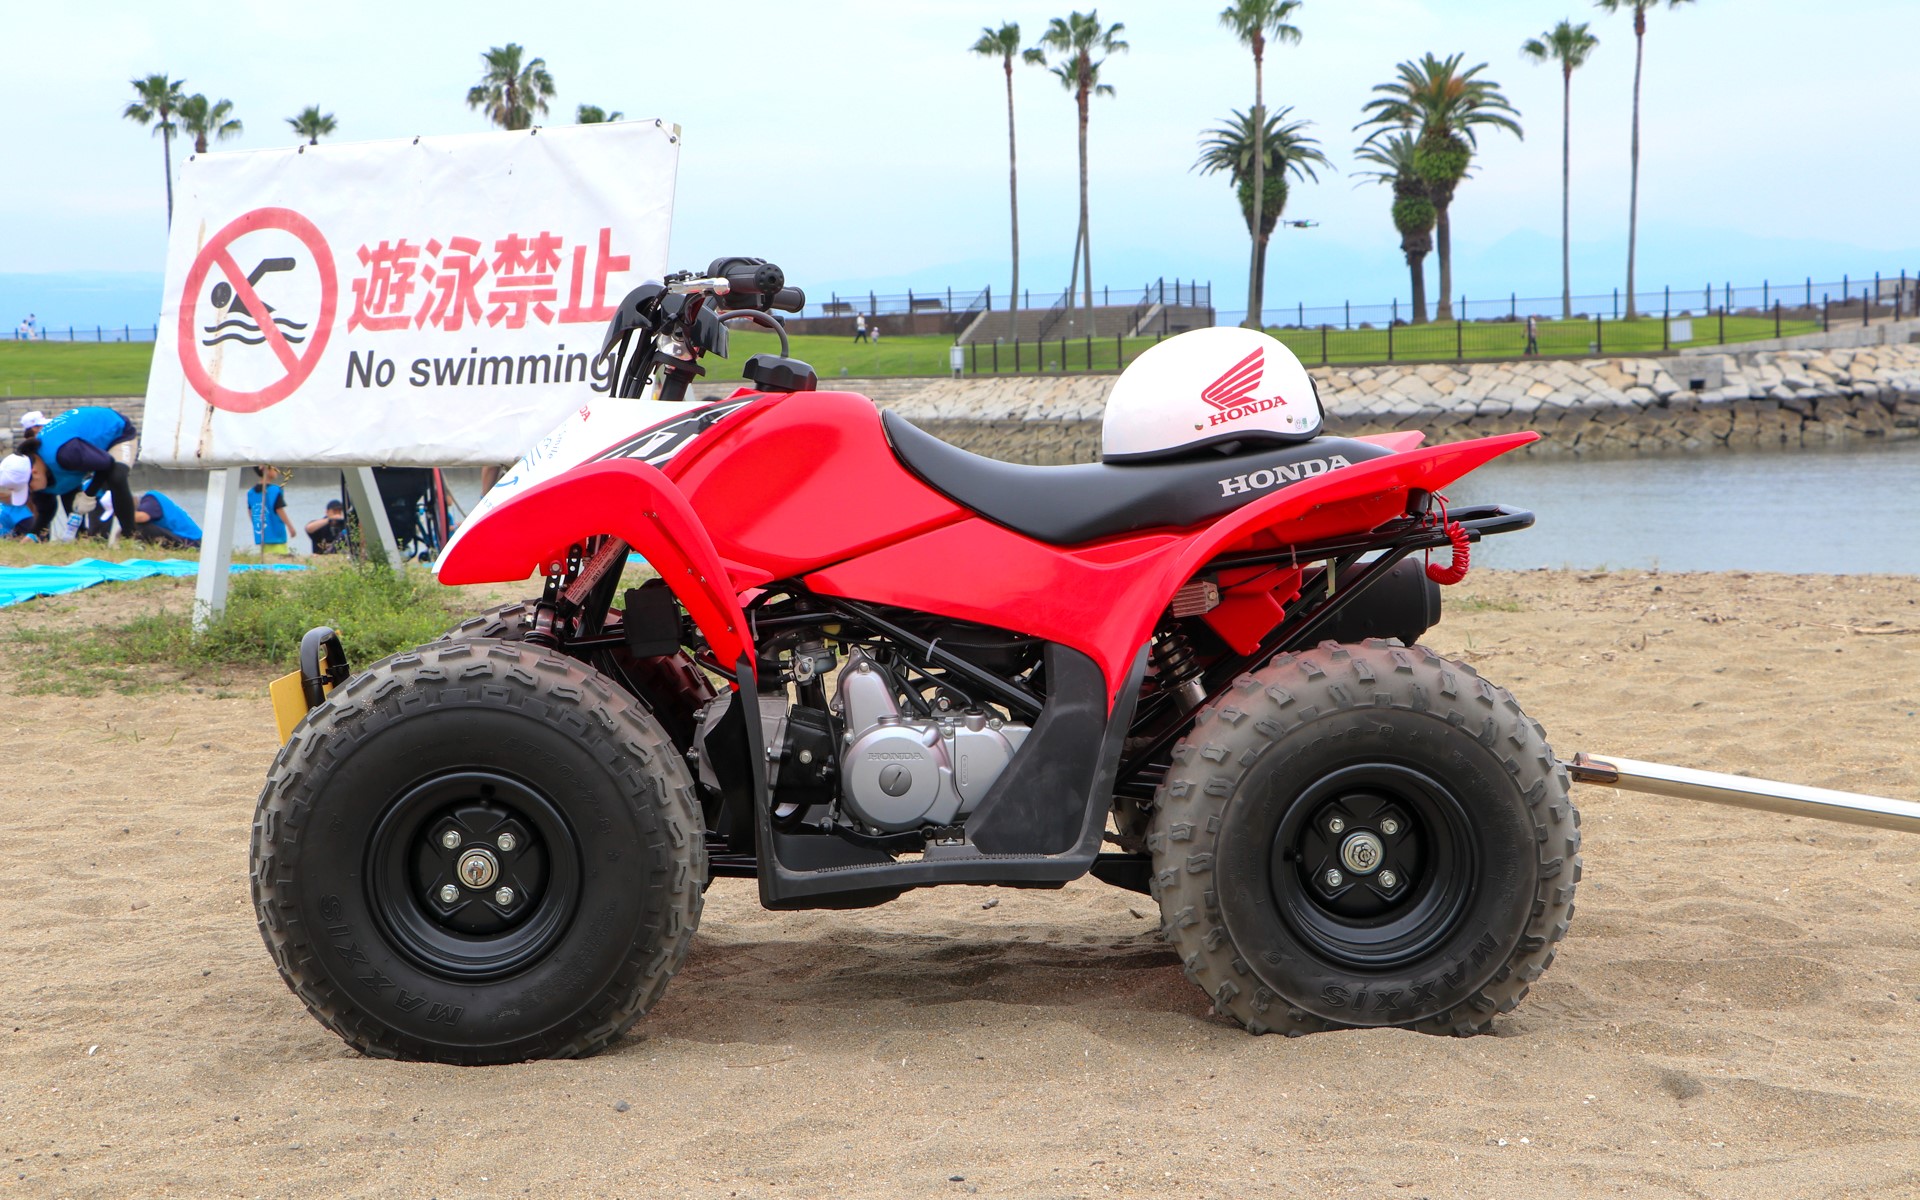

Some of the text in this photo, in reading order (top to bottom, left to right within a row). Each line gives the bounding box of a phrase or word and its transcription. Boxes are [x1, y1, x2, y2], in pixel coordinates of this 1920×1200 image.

[347, 227, 631, 334] 遊泳禁止
[345, 344, 618, 392] No swimming
[1207, 395, 1288, 427] HONDA
[1218, 454, 1352, 498] HONDA
[868, 752, 924, 761] HONDA
[320, 892, 465, 1028] MAXXIS
[1319, 931, 1501, 1013] MAXXIS
